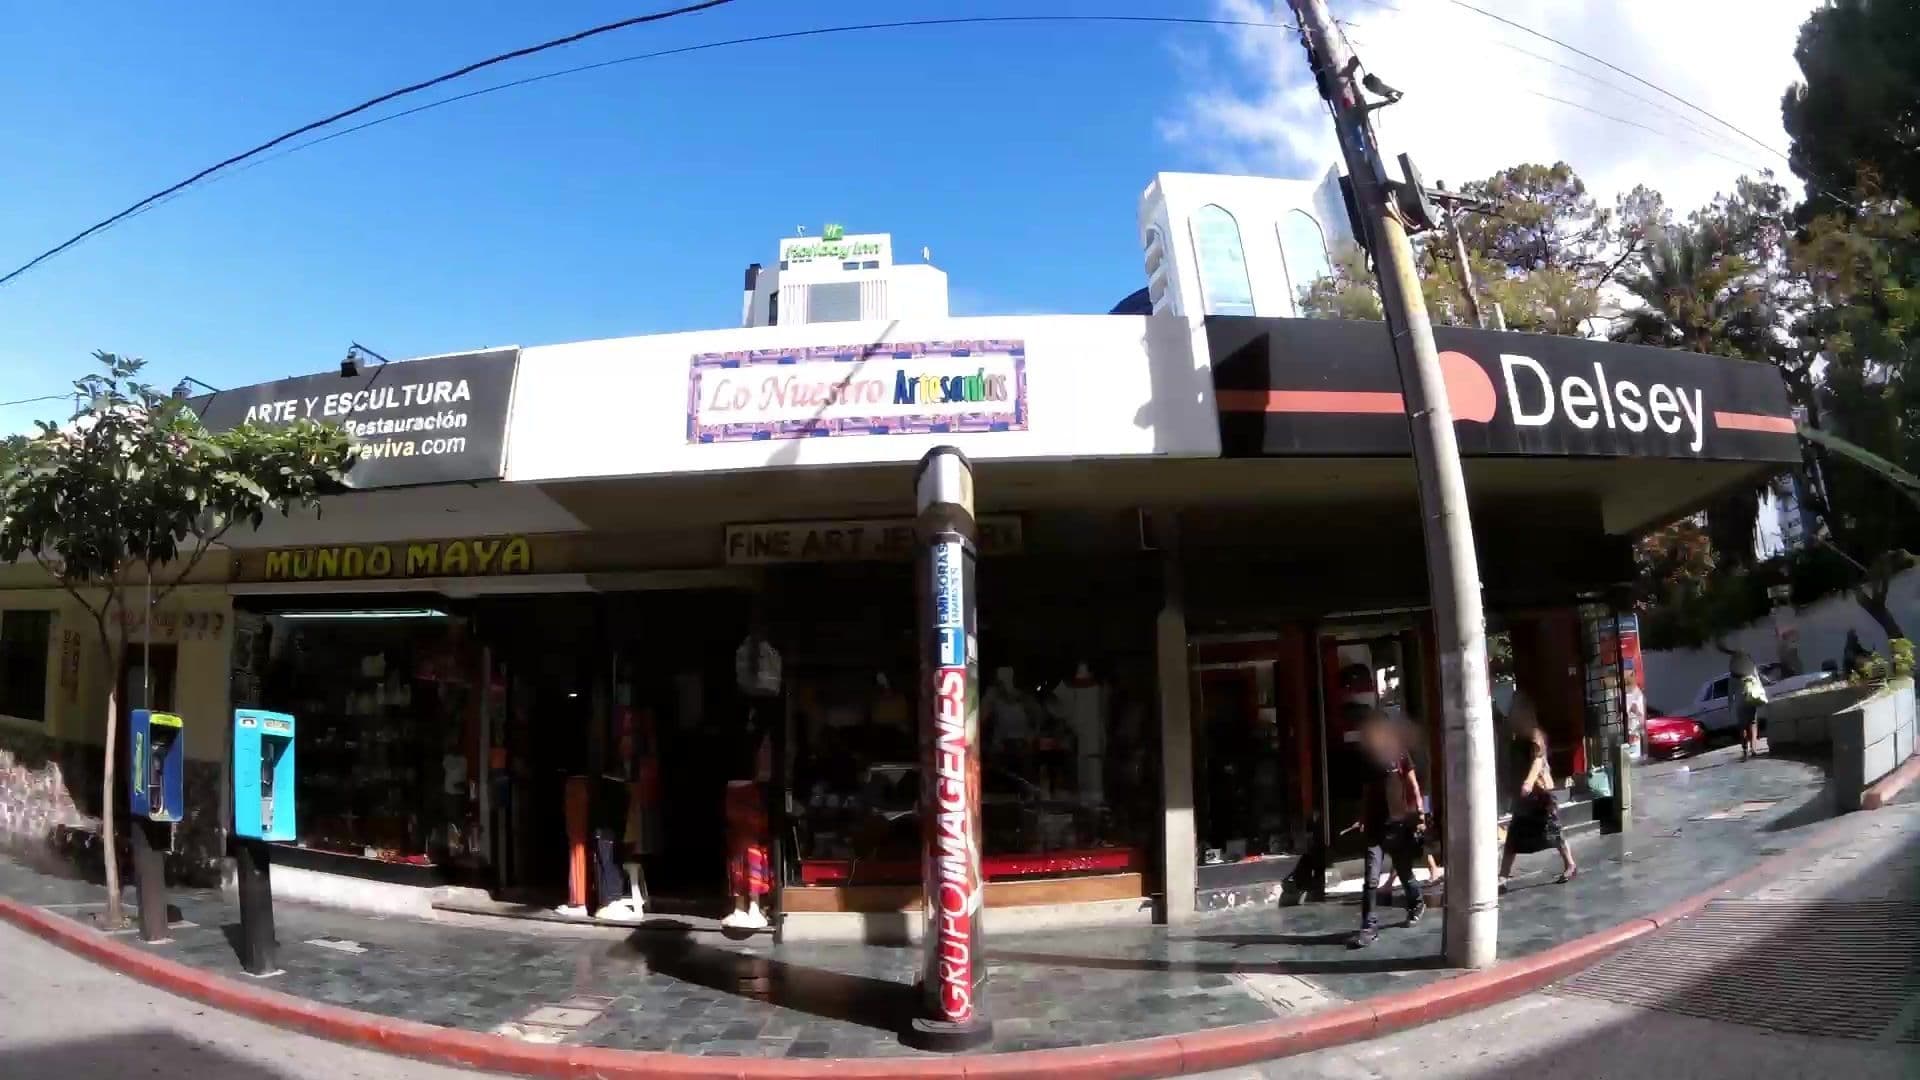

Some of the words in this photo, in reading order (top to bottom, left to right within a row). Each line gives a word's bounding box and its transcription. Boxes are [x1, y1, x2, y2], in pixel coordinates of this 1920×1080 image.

[244, 399, 298, 426] ARTE
[304, 396, 319, 418] Y
[323, 379, 471, 417] ESCULTURA
[709, 377, 751, 412] Lo
[757, 366, 884, 411] Nuestro
[1499, 353, 1703, 452] Delsey
[265, 543, 393, 580] MUNDO
[406, 534, 533, 577] MAYA
[729, 530, 790, 558] FINE
[801, 528, 864, 557] ART
[936, 543, 950, 625] EMISORAS
